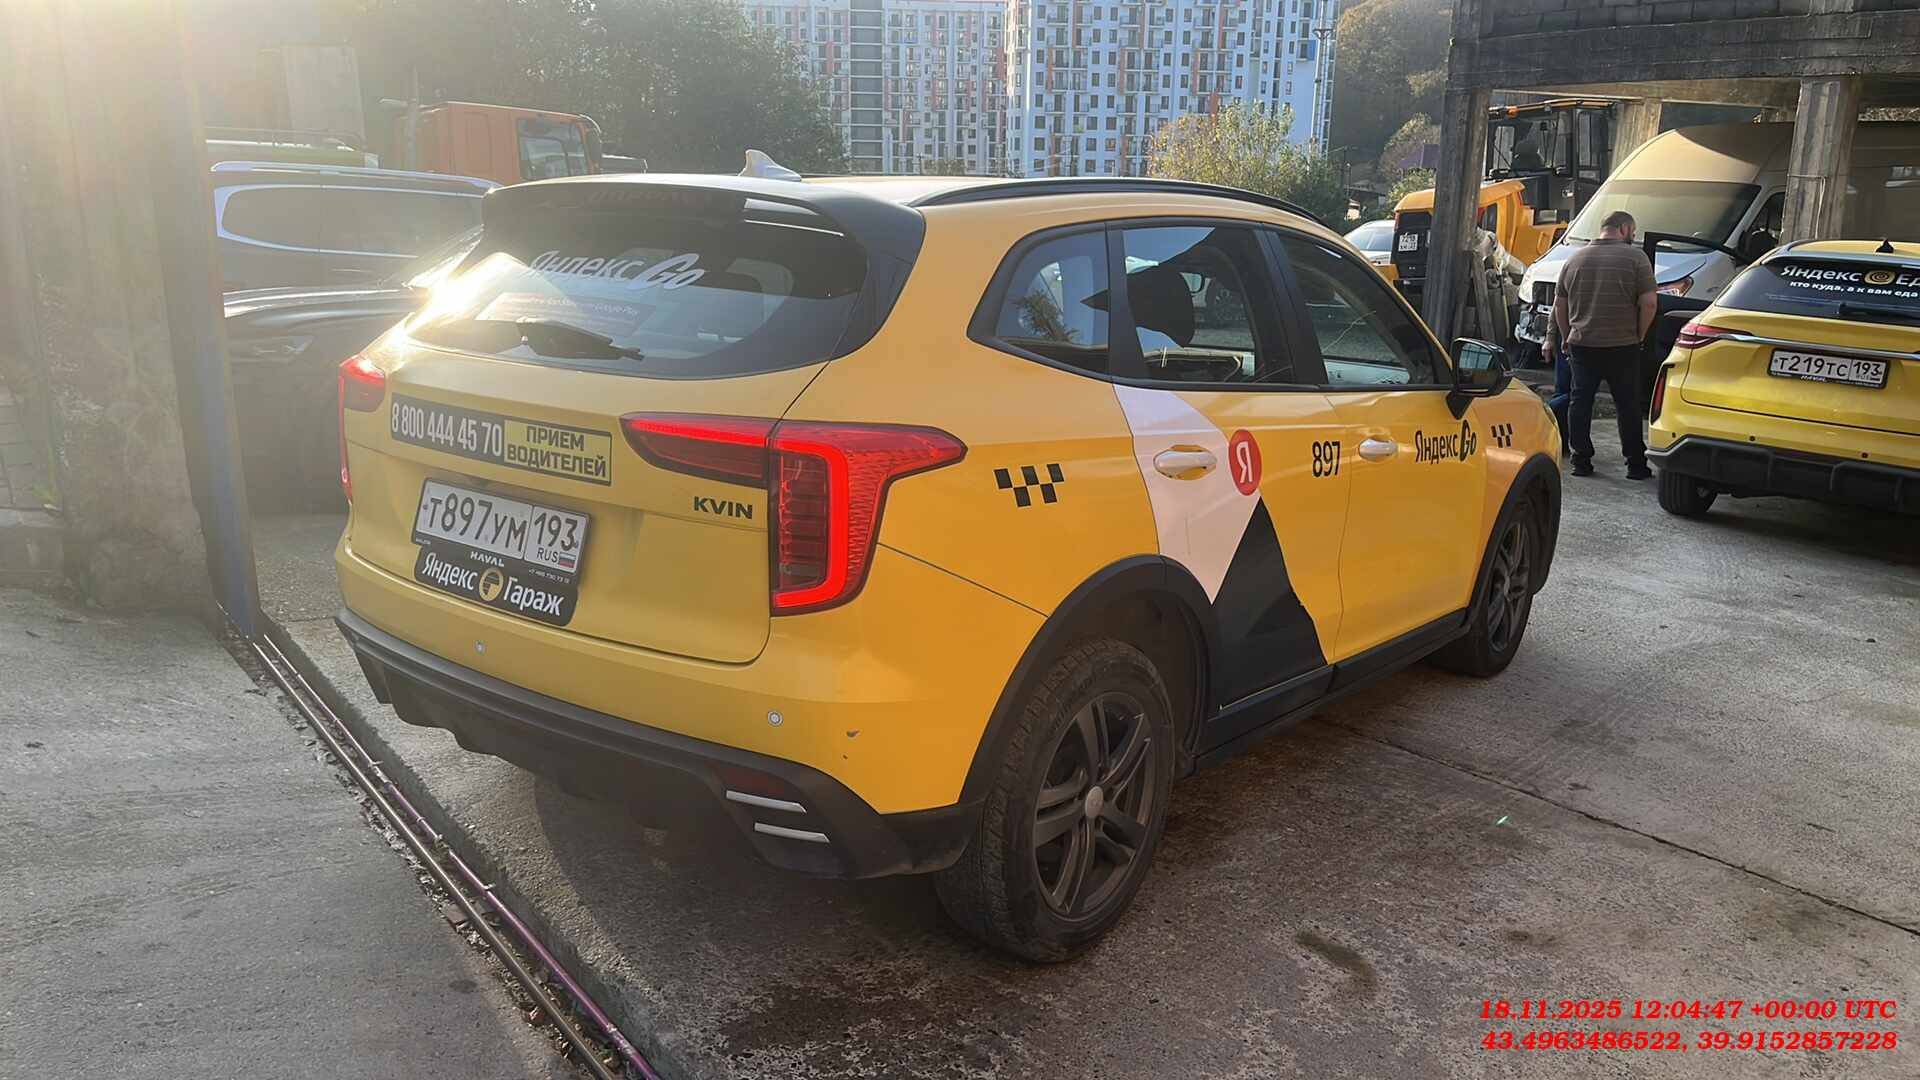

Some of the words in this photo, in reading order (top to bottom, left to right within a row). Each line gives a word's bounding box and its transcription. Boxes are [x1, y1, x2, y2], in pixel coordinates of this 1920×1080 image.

[528, 251, 645, 282] Яндекс
[626, 253, 705, 290] Go
[1780, 264, 1862, 282] Яндекс
[1812, 283, 1844, 292] куда,
[1894, 290, 1918, 298] еда
[1779, 355, 1848, 377] Т219ТС
[1853, 361, 1880, 377] 193
[391, 402, 400, 432] 8
[401, 405, 424, 439] 800
[427, 412, 454, 447] 444
[457, 417, 477, 451] 45
[481, 421, 502, 456] 70
[526, 425, 585, 451] ПРИЕМ
[1414, 430, 1458, 464] Яндекс
[1459, 419, 1477, 461] Go
[507, 444, 607, 478] ВОДИТЕЛЕЙ
[1236, 440, 1254, 483] Я
[1312, 441, 1340, 478] 897
[429, 492, 527, 552] Т897УМ
[534, 512, 578, 551] 193
[693, 496, 752, 519] KVIN
[470, 551, 504, 567] HAVAL
[536, 547, 558, 563] RUS
[422, 552, 478, 591] Яндекс
[504, 576, 564, 616] Гараж
